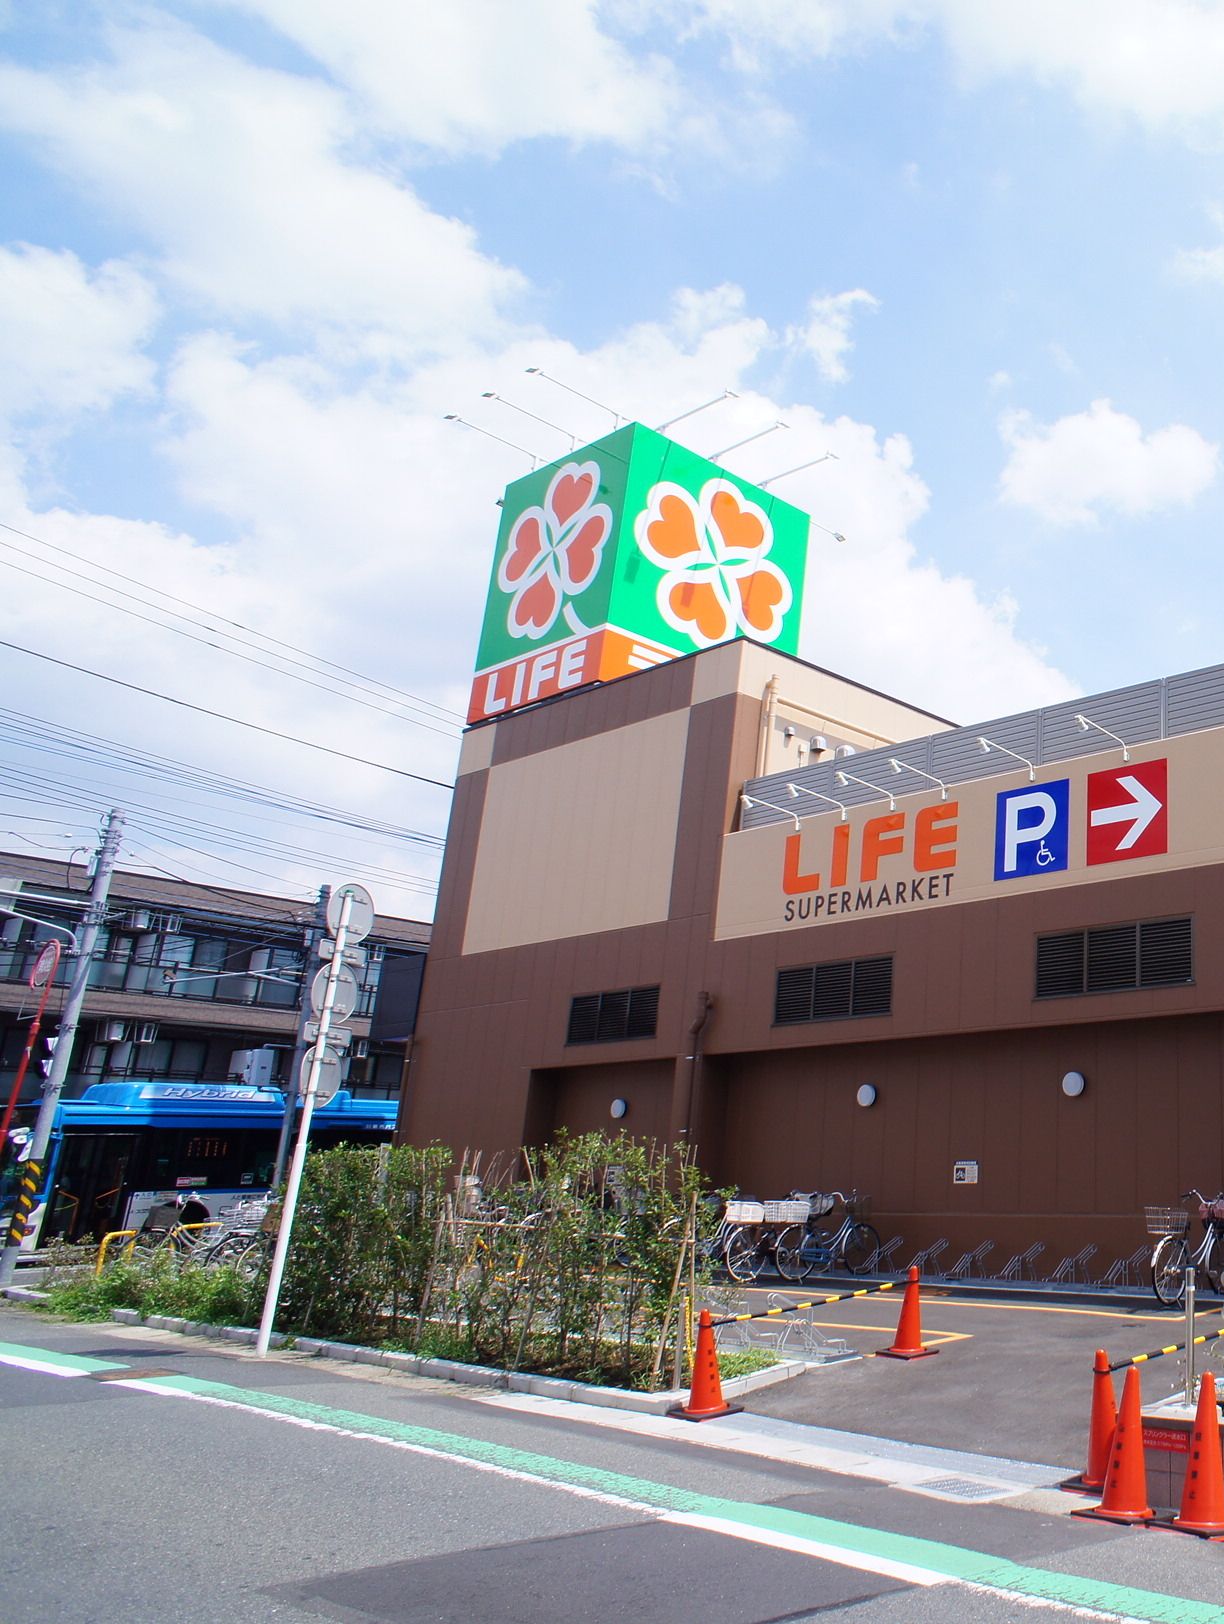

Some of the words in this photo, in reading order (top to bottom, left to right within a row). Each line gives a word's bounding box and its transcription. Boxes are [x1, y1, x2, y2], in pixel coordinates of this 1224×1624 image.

[483, 639, 588, 715] LIFE
[783, 801, 959, 895] LIFE
[1003, 791, 1058, 873] P
[784, 873, 955, 922] SUPERMARKET
[163, 1087, 257, 1099] Hybrid
